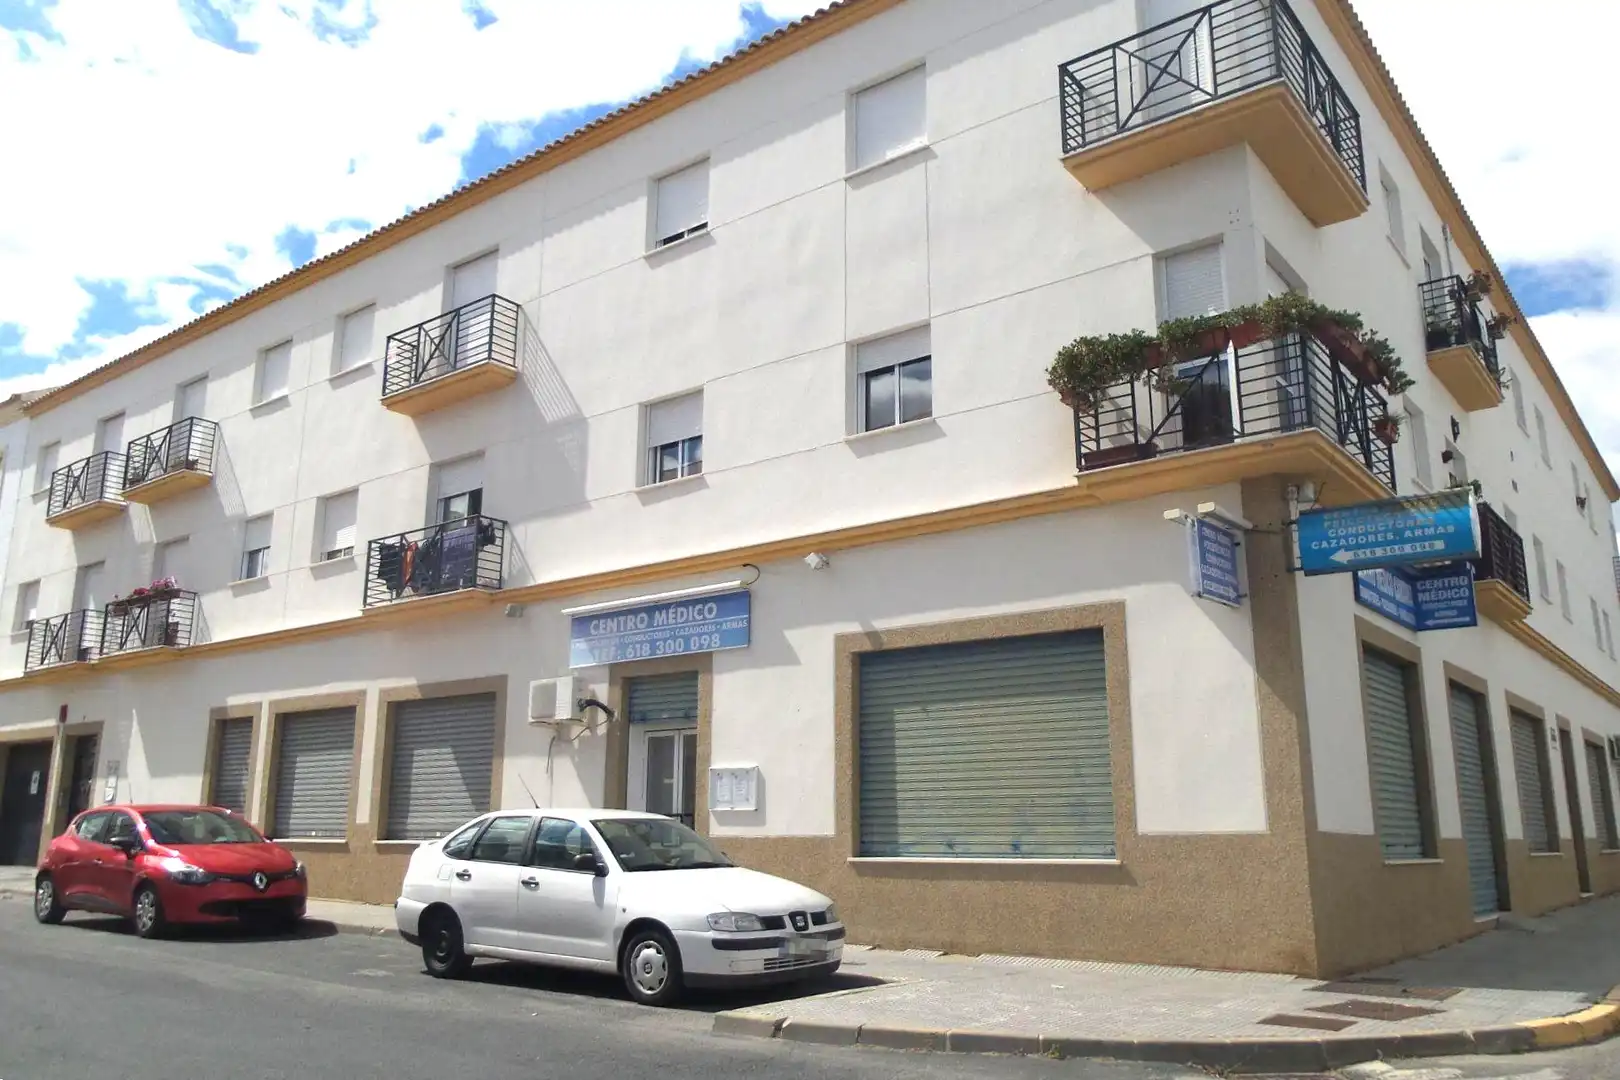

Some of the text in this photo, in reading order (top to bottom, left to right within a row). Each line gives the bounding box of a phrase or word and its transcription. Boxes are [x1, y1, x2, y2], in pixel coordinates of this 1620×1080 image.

[1404, 525, 1455, 538] ARMAS
[1353, 550, 1377, 558] 618
[1382, 546, 1405, 555] 300
[1417, 576, 1468, 590] CENTRO
[590, 602, 718, 636] CENTRO MÉDICO
[722, 620, 749, 631] ARMAS
[626, 641, 651, 659] 618
[656, 638, 685, 655] 300
[691, 633, 721, 650] 098
